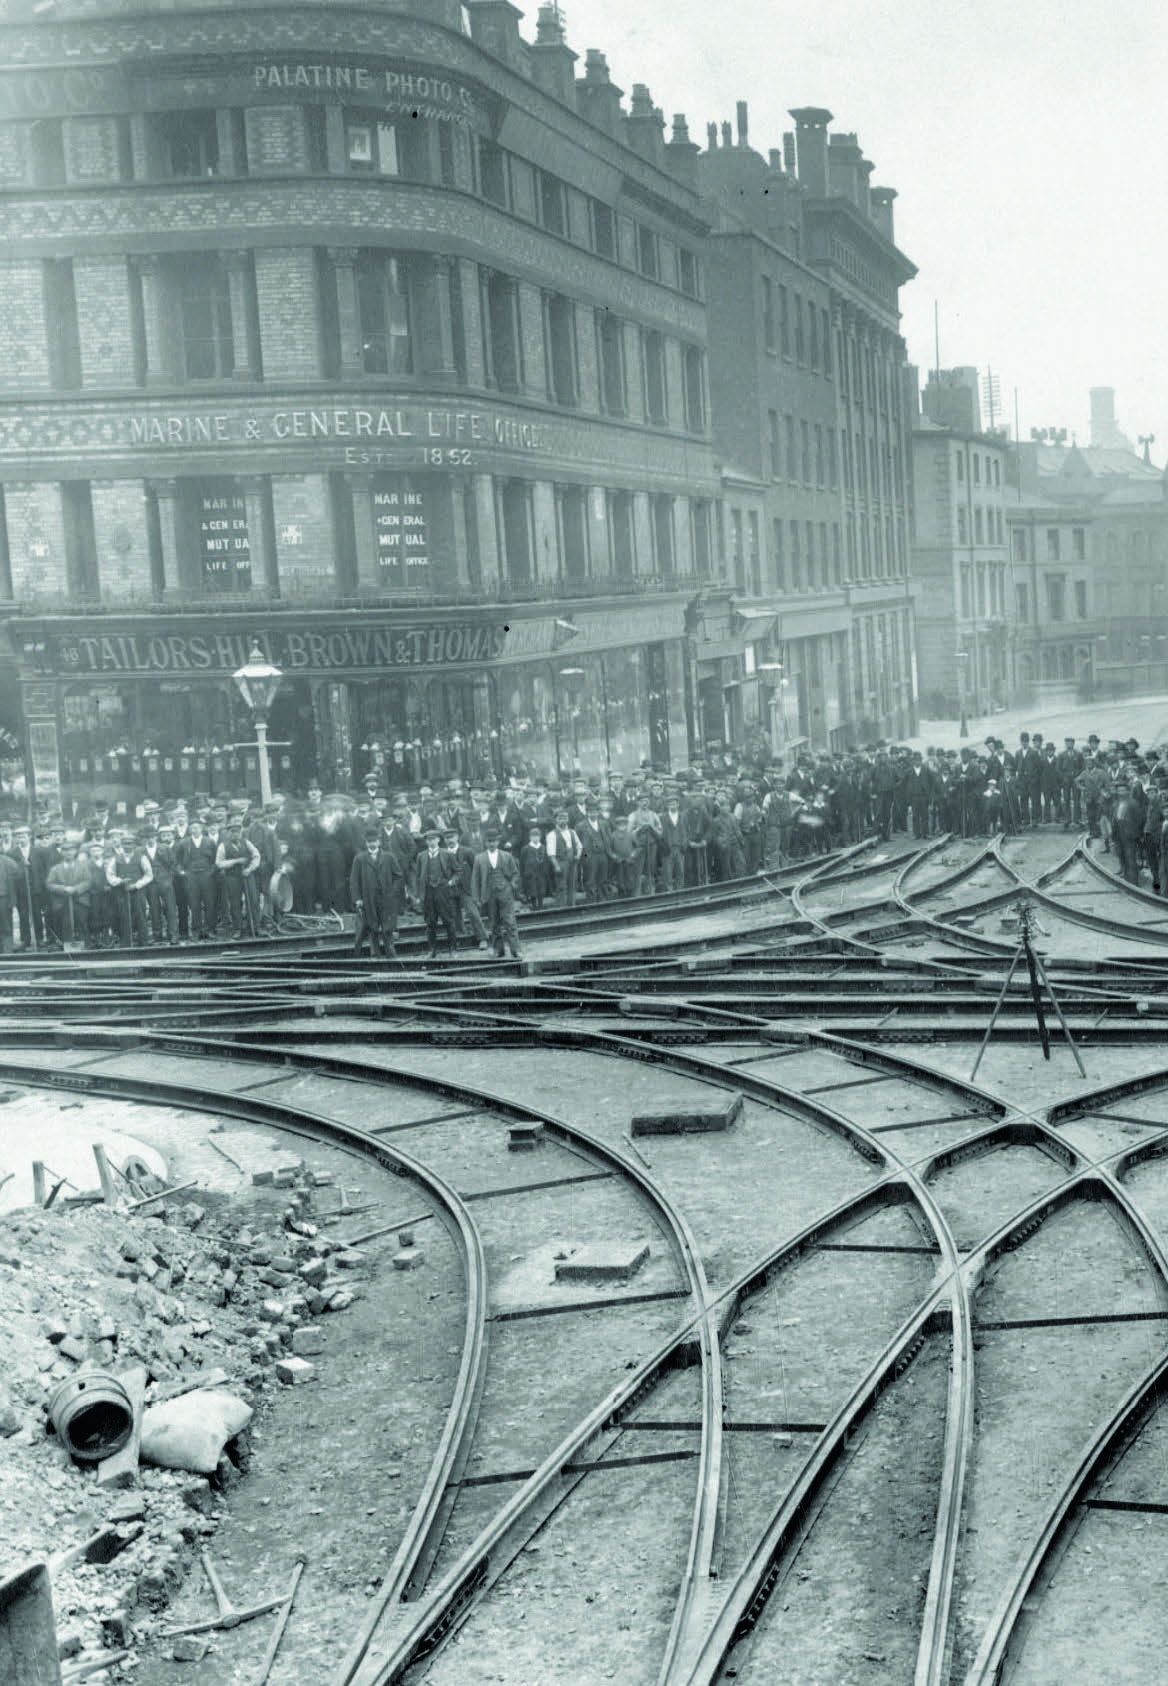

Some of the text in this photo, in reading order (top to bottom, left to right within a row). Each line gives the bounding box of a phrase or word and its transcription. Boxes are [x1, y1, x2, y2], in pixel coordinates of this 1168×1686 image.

[256, 65, 369, 88] PALATINE
[385, 71, 452, 101] PHOTO
[130, 415, 230, 443] MARINE
[246, 418, 264, 440] &
[271, 410, 416, 438] GENERAL
[427, 410, 482, 440] LIFE
[207, 538, 249, 551] MUTUA
[79, 635, 213, 669] TAILORS
[286, 630, 392, 667] BROWN
[394, 638, 412, 665] &
[407, 628, 501, 664] THOMAS
